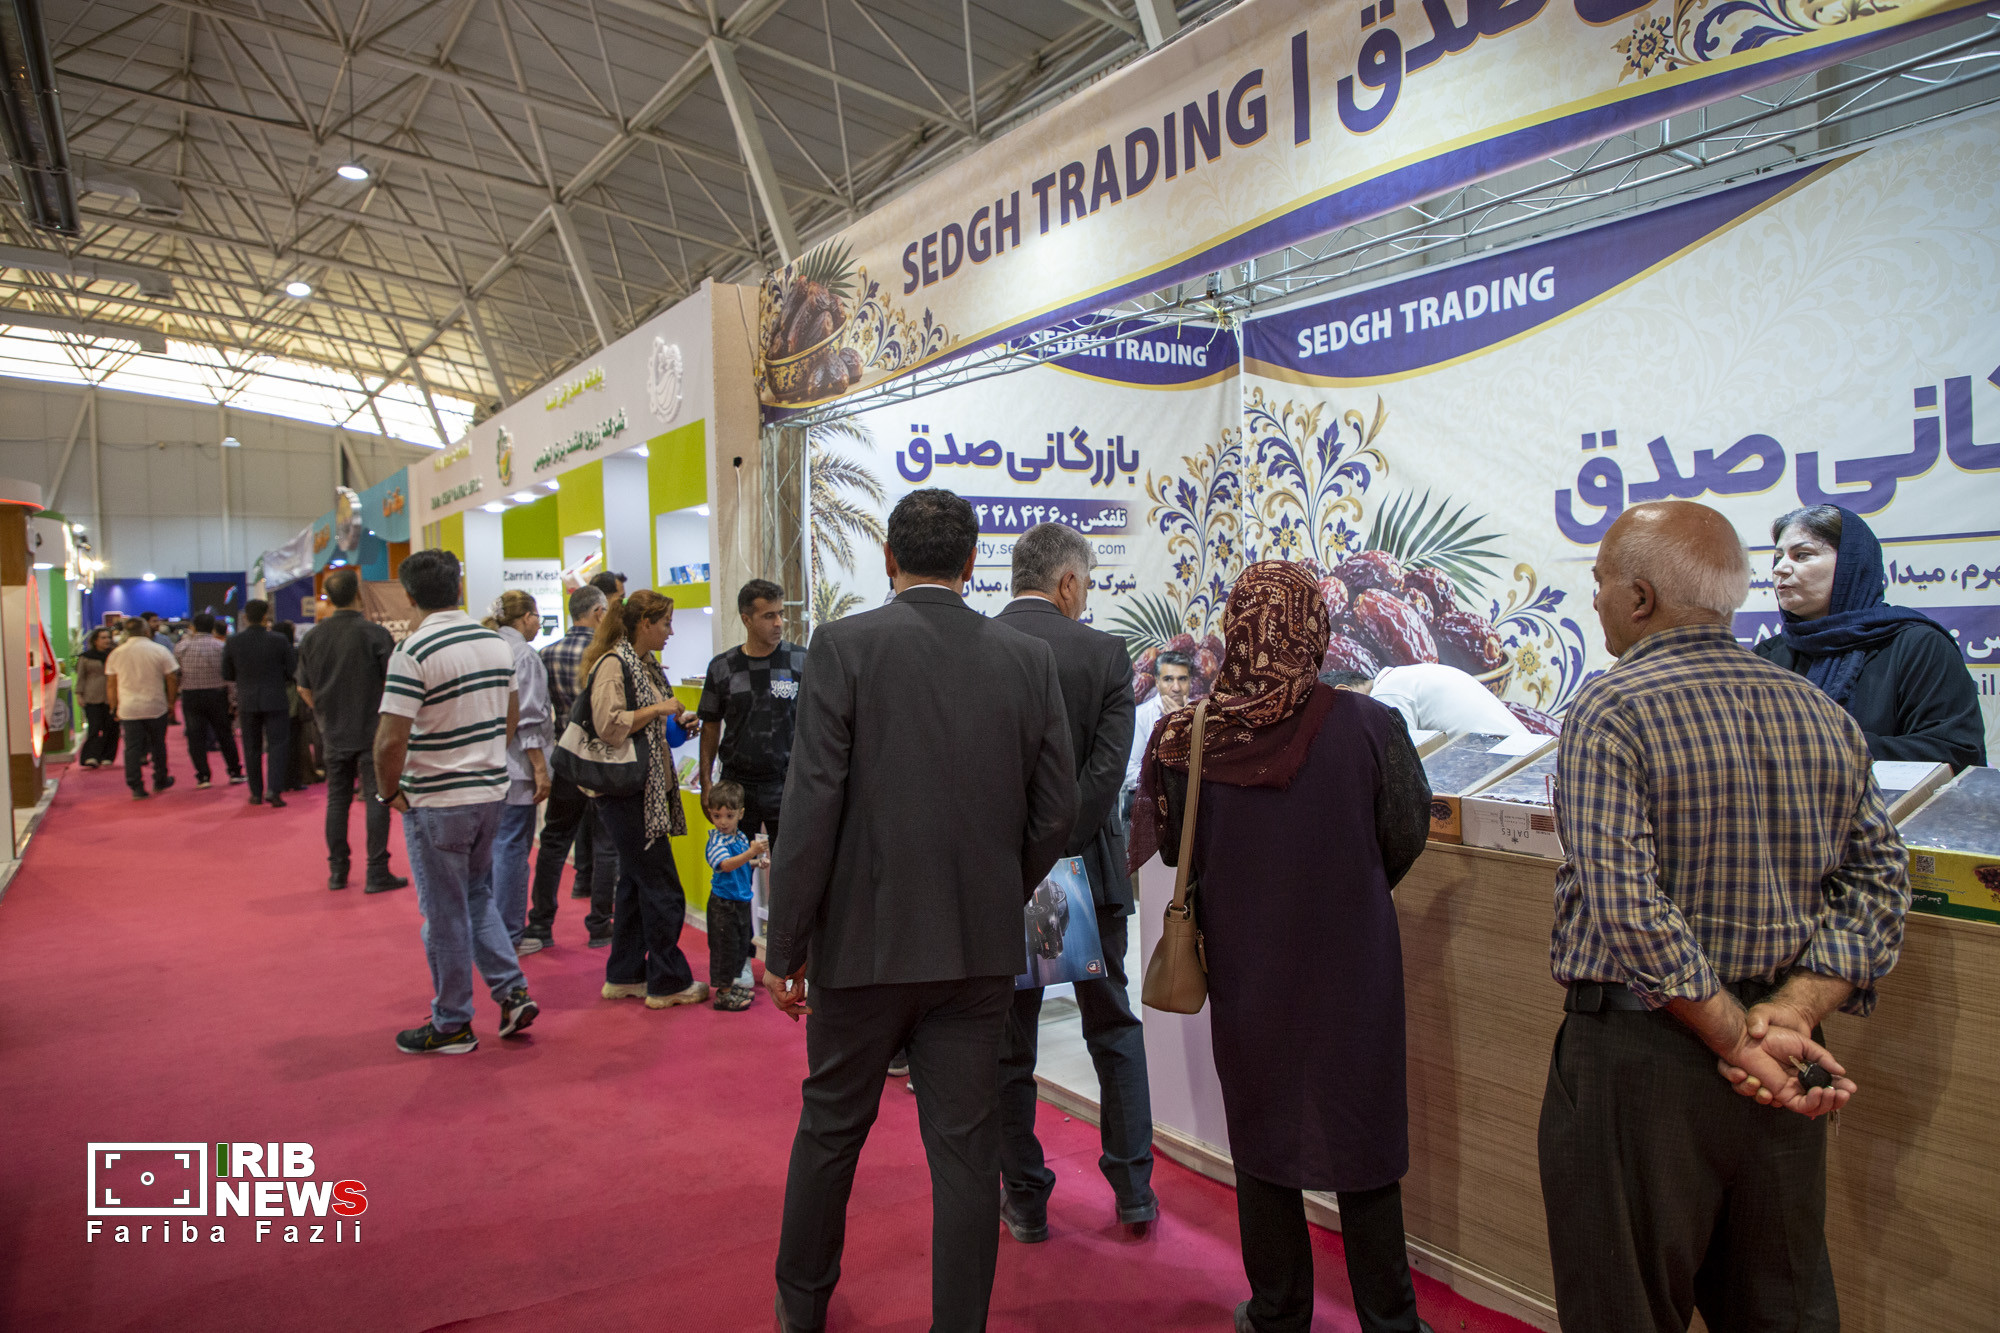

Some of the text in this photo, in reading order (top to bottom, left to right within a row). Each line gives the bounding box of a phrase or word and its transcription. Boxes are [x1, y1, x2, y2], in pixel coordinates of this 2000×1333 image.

[902, 190, 1021, 295] SEDGH
[1032, 68, 1268, 237] TRADING
[1297, 265, 1555, 358] SEDGH TRADING
[1114, 338, 1207, 367] TRADING
[896, 424, 1140, 487] بازرگانی صدق
[1555, 429, 1787, 546] صدق
[1098, 574, 1137, 596] شهرک
[1882, 560, 1946, 591] میدا
